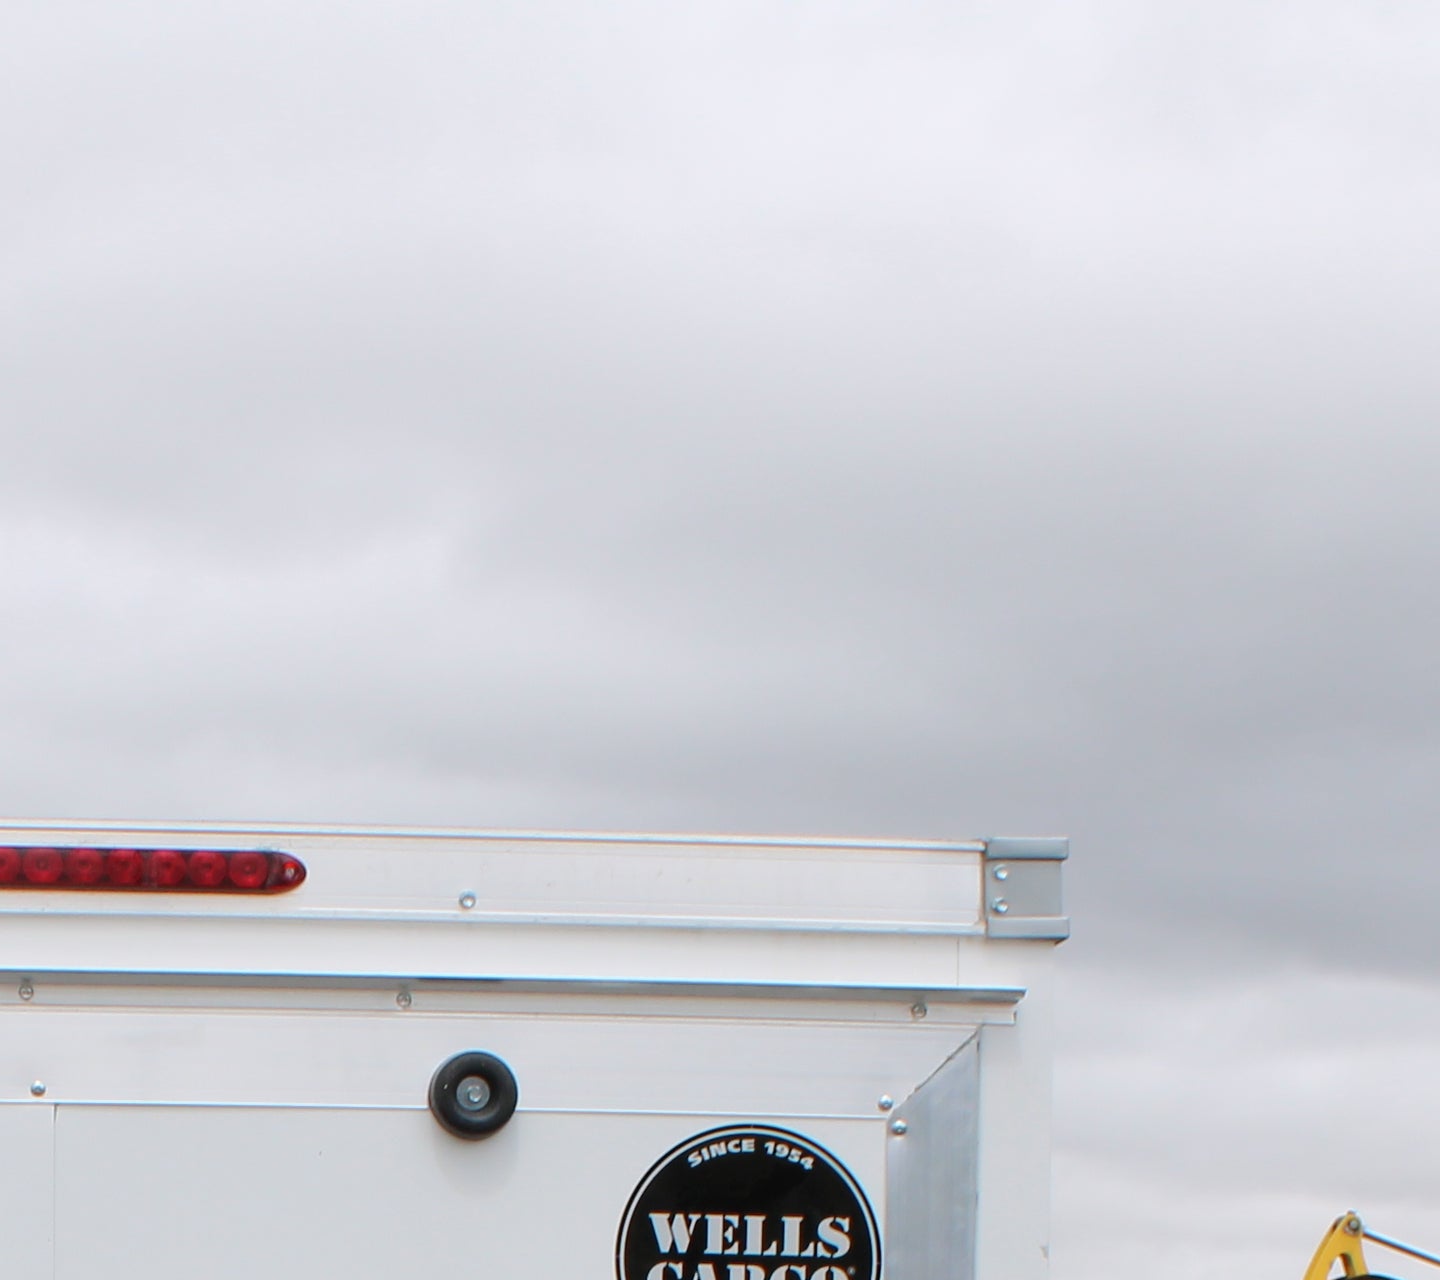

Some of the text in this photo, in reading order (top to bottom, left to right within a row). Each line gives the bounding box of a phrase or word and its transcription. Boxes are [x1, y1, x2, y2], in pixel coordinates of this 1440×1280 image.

[687, 1138, 816, 1171] SINCE 1954
[648, 1212, 852, 1259] WELLS
